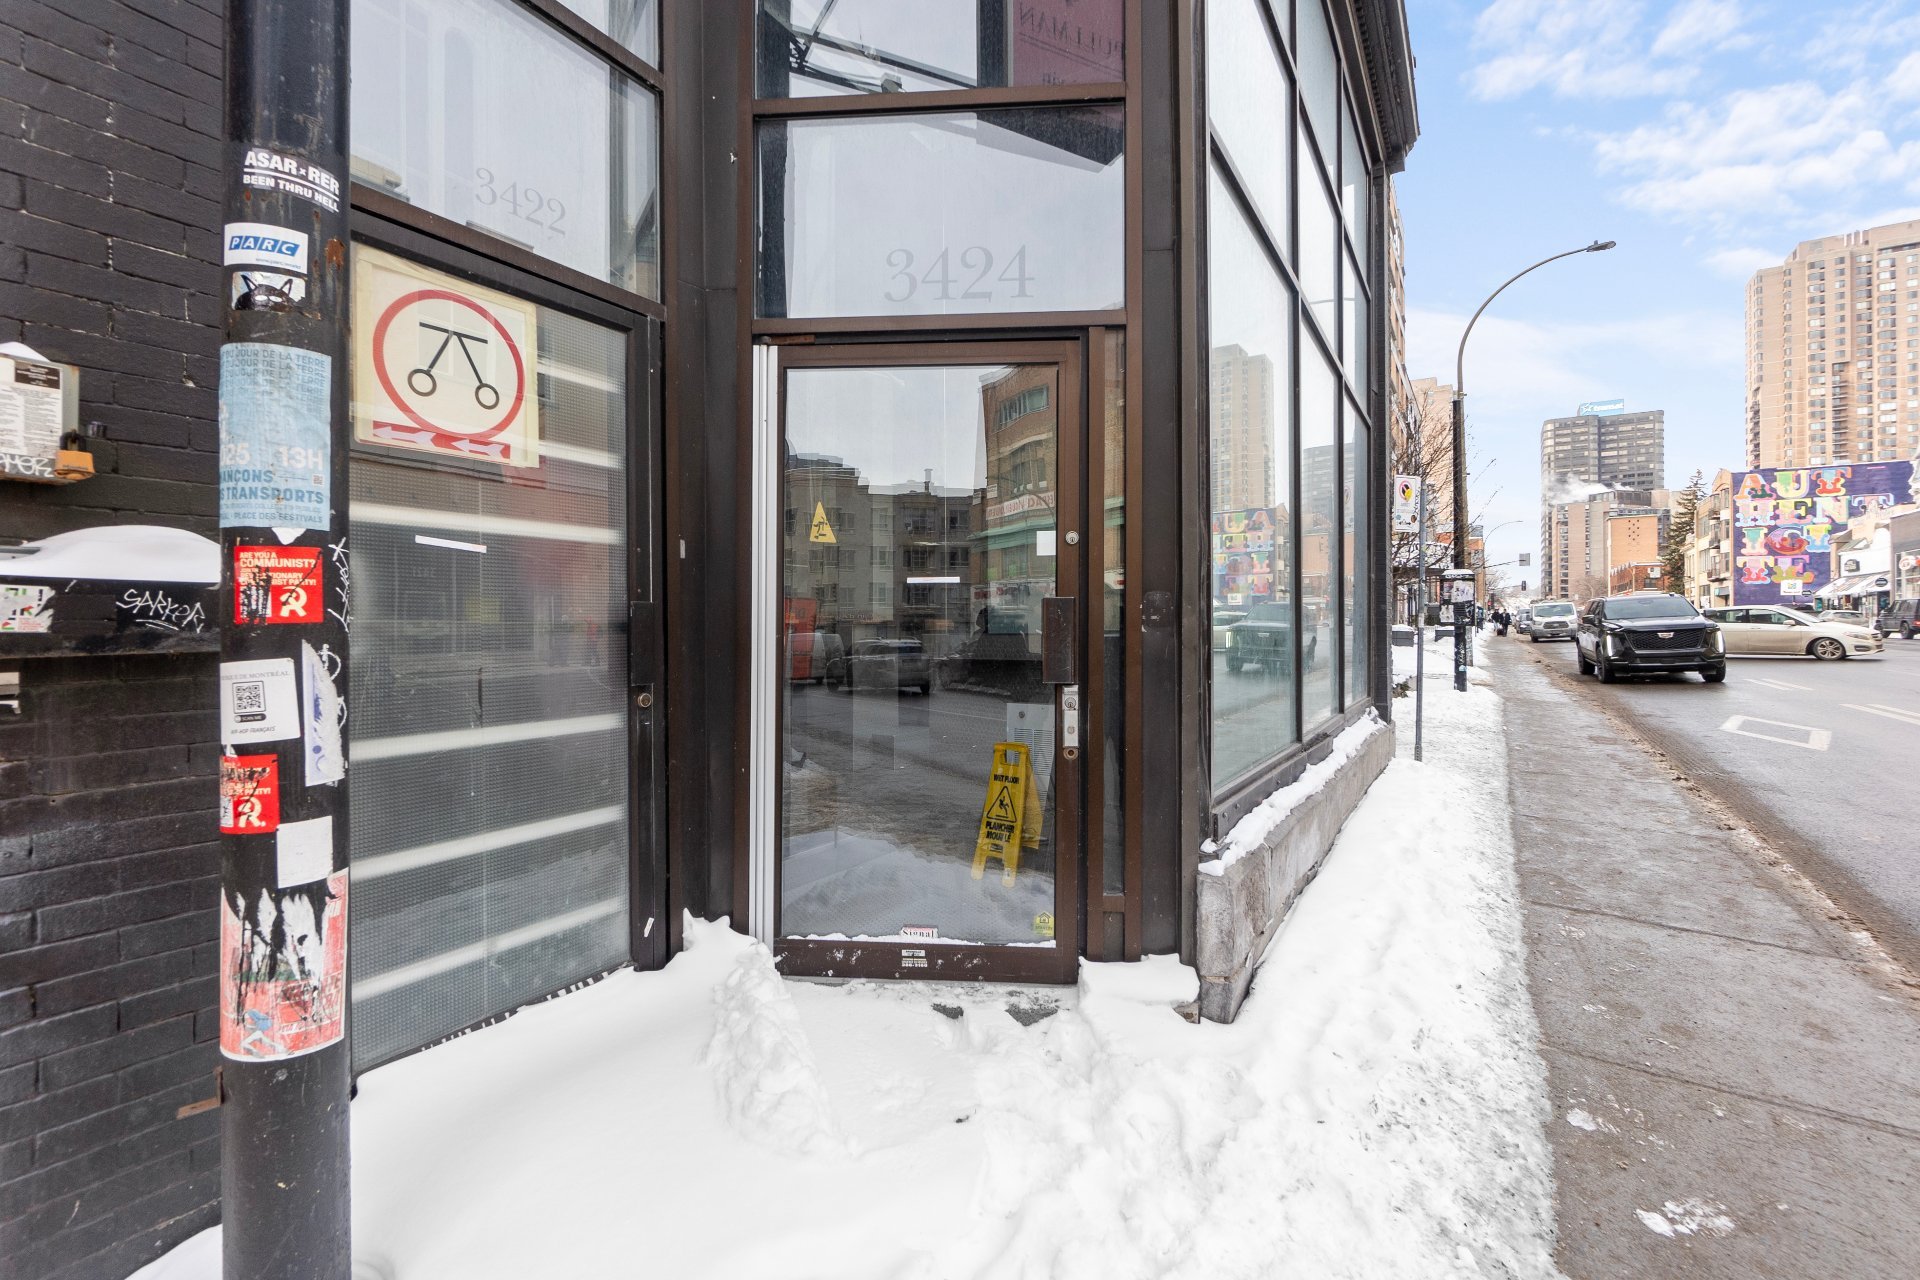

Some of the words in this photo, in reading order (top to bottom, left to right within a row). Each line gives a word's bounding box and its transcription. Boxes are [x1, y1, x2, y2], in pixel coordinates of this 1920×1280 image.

[244, 151, 297, 175] ASAR
[308, 166, 339, 195] RER
[243, 174, 275, 187] BEEN
[277, 179, 313, 198] THRU
[314, 190, 339, 213] HELL
[475, 167, 566, 238] 3422
[230, 237, 296, 254] PARC
[884, 244, 1035, 303] 3424
[235, 349, 259, 358] JOUR
[262, 349, 276, 359] DE
[280, 352, 293, 361] LA
[295, 354, 326, 369] TERRE
[262, 360, 276, 369] DE
[280, 361, 292, 370] LA
[279, 446, 324, 471] 13H
[227, 487, 324, 505] TRANSPORTS
[259, 513, 277, 521] DES
[240, 558, 316, 568] COMMUNIST?
[993, 774, 1004, 782] WET
[1004, 775, 1020, 785] FLOOR
[985, 821, 1015, 834] PLANCHER
